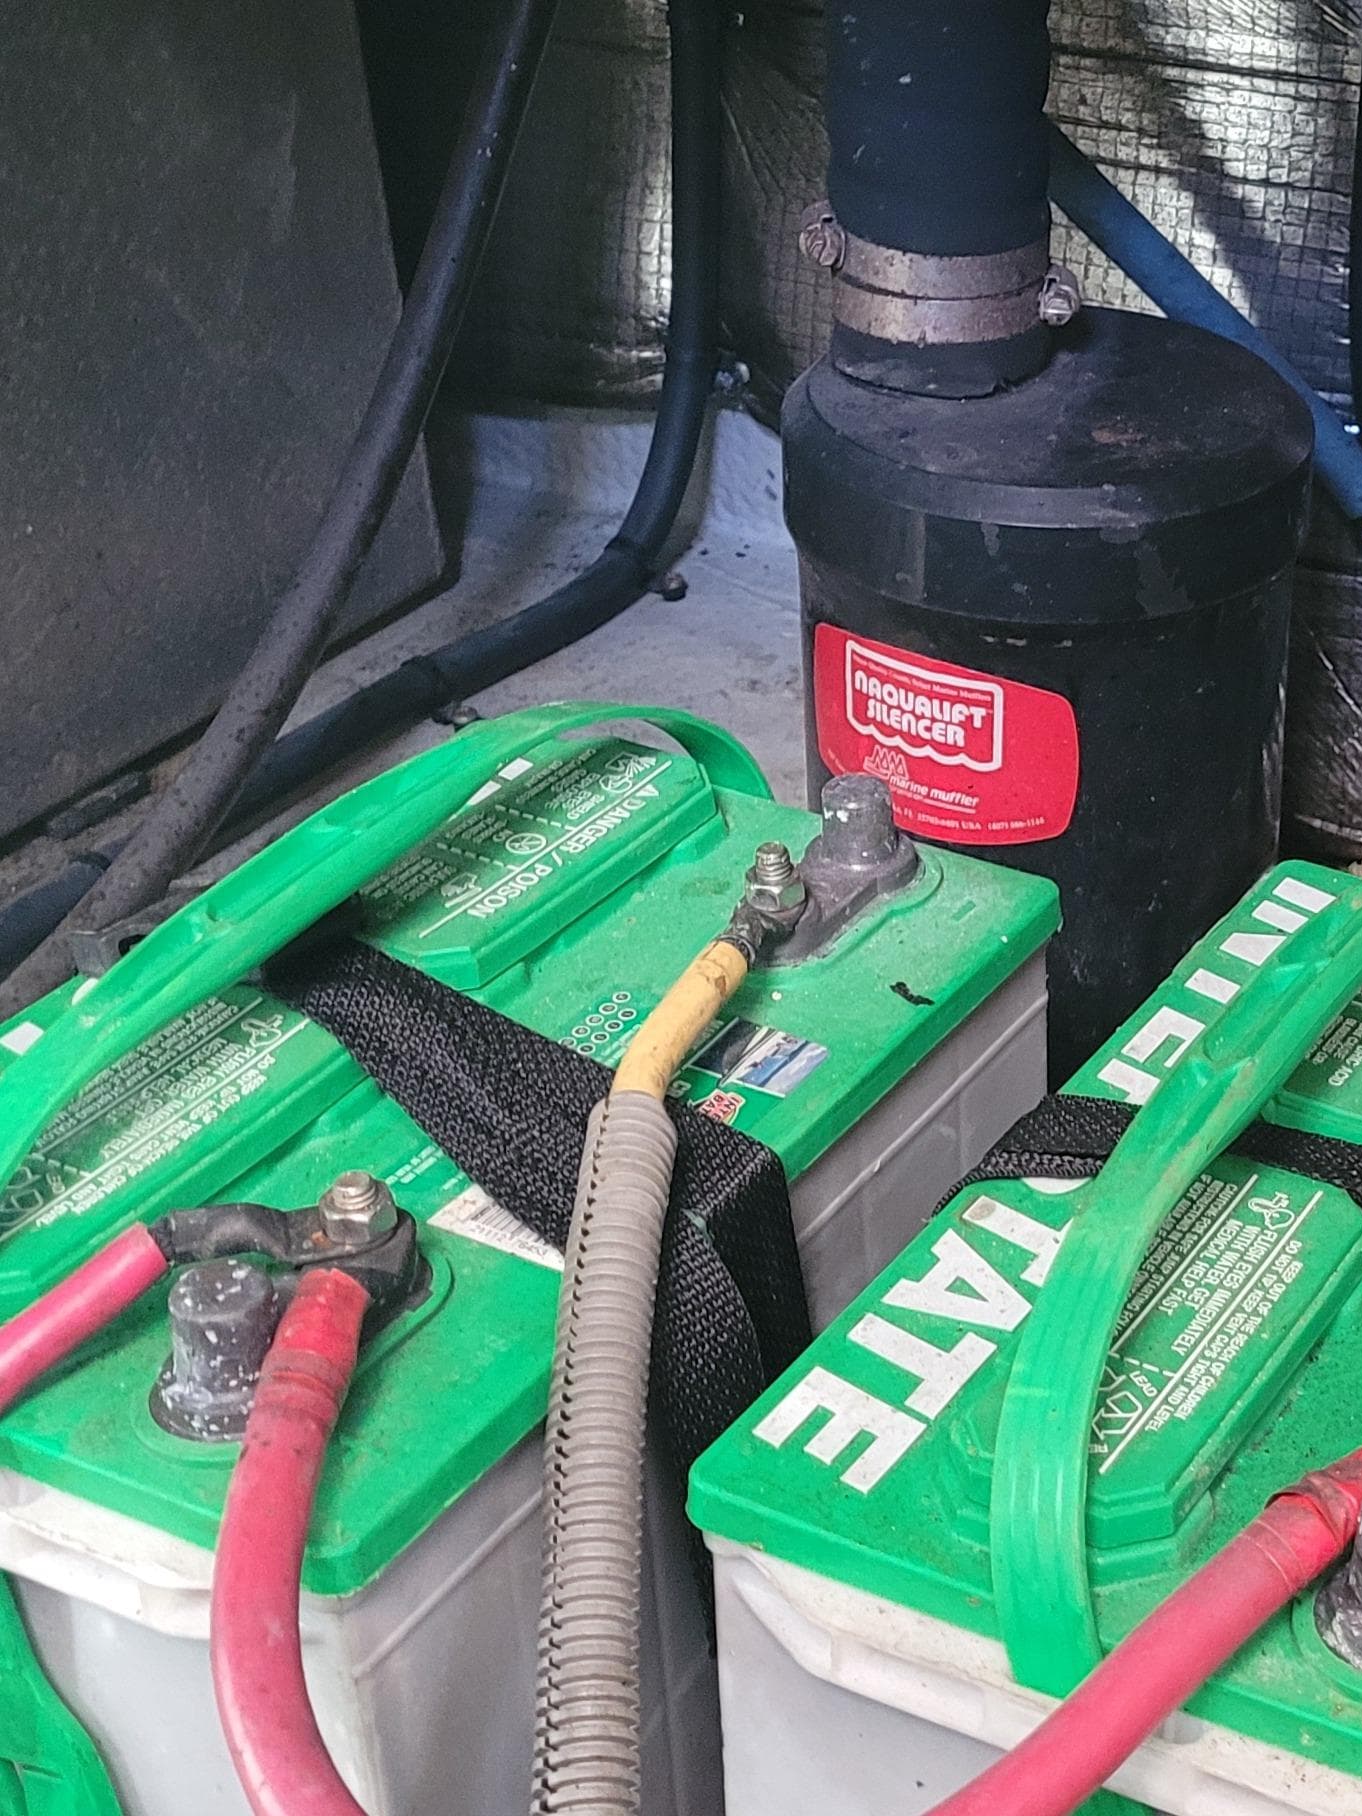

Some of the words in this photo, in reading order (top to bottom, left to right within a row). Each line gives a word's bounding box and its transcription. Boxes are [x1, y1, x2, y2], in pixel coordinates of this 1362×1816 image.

[867, 699, 966, 748] SILENCER
[889, 775, 929, 796] marine
[930, 787, 980, 808] muffler
[554, 796, 650, 855] DANGER
[538, 849, 575, 867] /
[463, 860, 557, 918] POISON
[209, 1044, 259, 1079] FLUSH
[1325, 1064, 1355, 1087] ACID
[753, 877, 1337, 1494] INETATE
[1187, 1216, 1213, 1235] FOR
[1197, 1217, 1245, 1261] MEDICAL
[1228, 1223, 1262, 1251] WITH
[1240, 1229, 1279, 1263] FLUSH
[1282, 1239, 1304, 1254] DO
[1176, 1259, 1211, 1288] HELP
[1198, 1249, 1241, 1288] WATER.
[1219, 1260, 1255, 1289] EYES
[1268, 1252, 1294, 1273] NOT
[1277, 1259, 1306, 1283] KEEP
[1124, 1271, 1166, 1312] STARTING
[1153, 1286, 1190, 1316] FAST
[1180, 1285, 1212, 1311] GET
[1237, 1287, 1266, 1313] KEEP
[1263, 1281, 1288, 1301] OUT
[1166, 1287, 1233, 1356] IMMEDIATELY
[1252, 1299, 1274, 1316] OF
[1220, 1311, 1248, 1334] VENT
[1238, 1314, 1263, 1333] THE
[1200, 1333, 1231, 1360] CAPS
[1216, 1331, 1249, 1361] REACH
[1179, 1357, 1212, 1386] TIGHT
[1205, 1360, 1227, 1375] OF
[1128, 1370, 1158, 1398] LEAD
[1164, 1383, 1192, 1405] AND
[1171, 1373, 1217, 1419] CHILDREN
[1142, 1403, 1176, 1433] LEVEL
